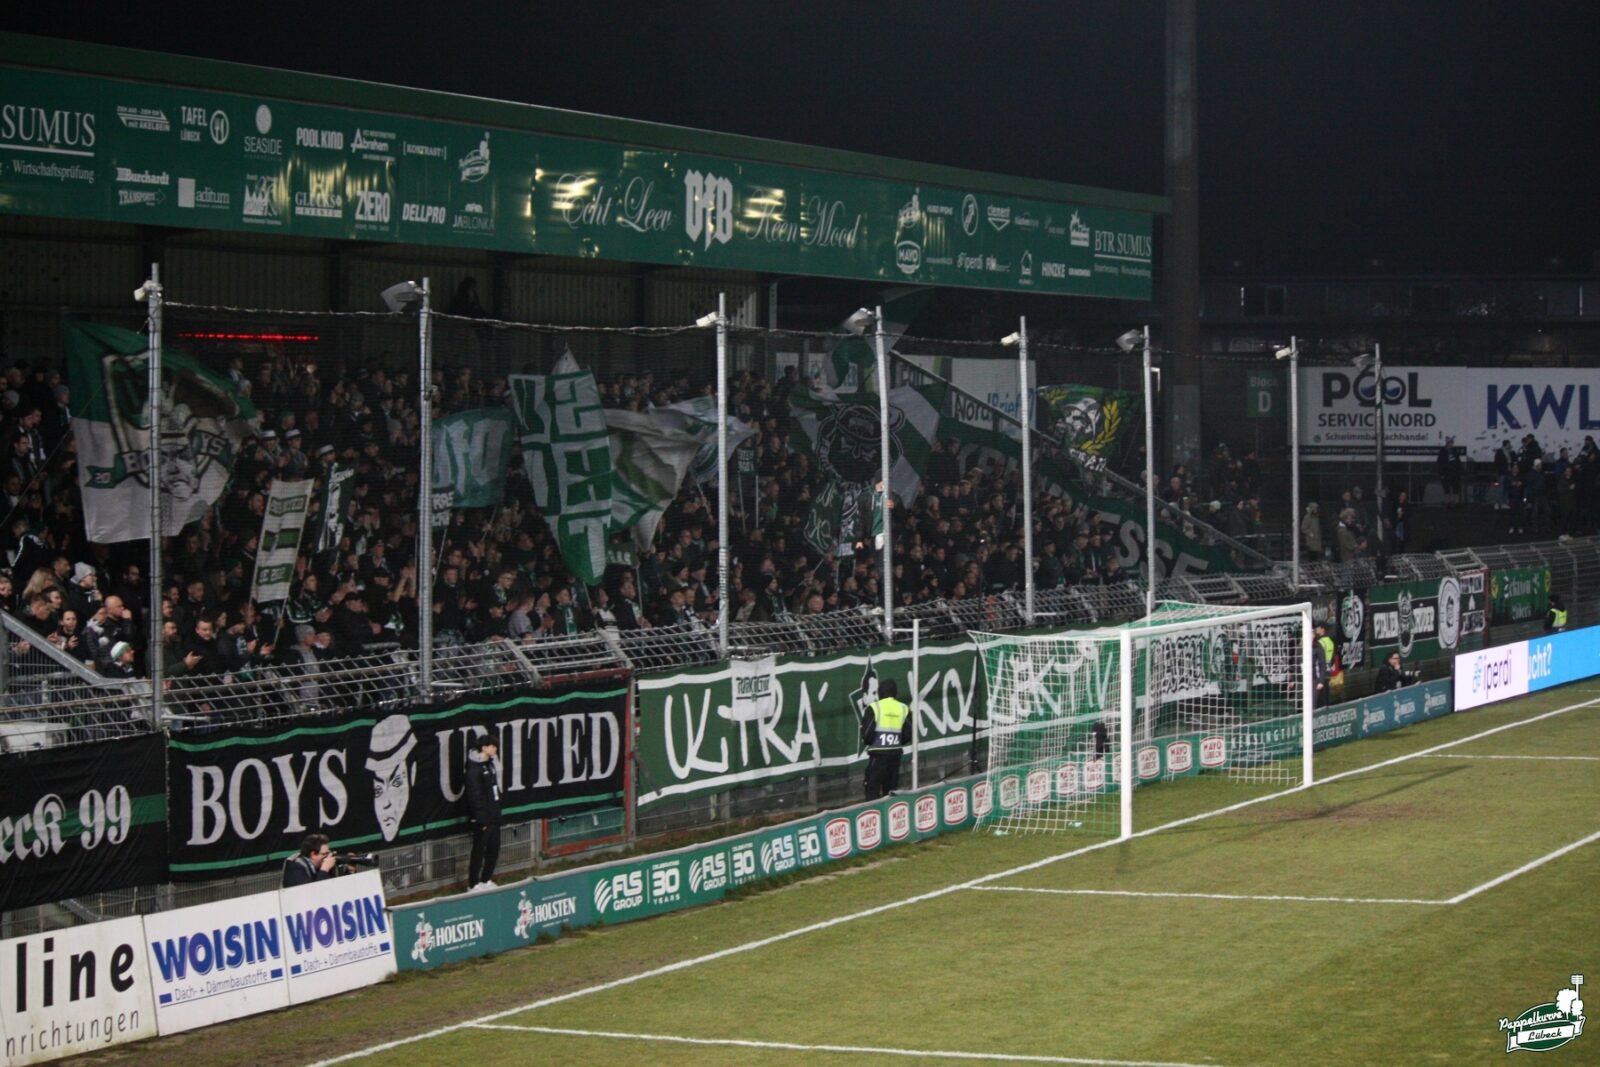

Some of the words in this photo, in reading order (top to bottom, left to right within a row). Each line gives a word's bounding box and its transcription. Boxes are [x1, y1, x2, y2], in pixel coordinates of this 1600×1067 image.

[2, 105, 96, 147] SUMUS
[181, 106, 208, 126] TAFEL
[244, 136, 283, 155] SEASIDE
[12, 159, 95, 184] Wirtschaftsprüfung
[402, 203, 446, 224] DELLPRO
[1094, 230, 1115, 253] BTR
[1117, 232, 1152, 258] SUMUS
[1257, 391, 1272, 412] D
[1317, 413, 1377, 428] SERVIC
[1388, 413, 1436, 428] NORD
[1483, 650, 1512, 700] iperdi
[187, 747, 348, 846] BOYS
[79, 785, 132, 850] 99
[829, 824, 846, 837] MAYO
[860, 815, 877, 829] MAYO
[772, 834, 794, 860] FLS
[798, 833, 820, 859] 30
[702, 852, 726, 880] FLS
[733, 850, 755, 877] 30
[774, 858, 796, 871] GROUP
[612, 870, 643, 899] FLS
[652, 868, 680, 896] 30
[703, 876, 726, 891] GROUP
[534, 897, 577, 923] HOLSTEN
[613, 896, 643, 911] GROUP
[654, 893, 680, 905] YEARS
[286, 894, 388, 955] WOISIN
[435, 919, 484, 947] HOLSTEN
[152, 917, 281, 983] WOISIN
[15, 937, 135, 1013] line
[206, 968, 269, 995] Dämmbaustoffe
